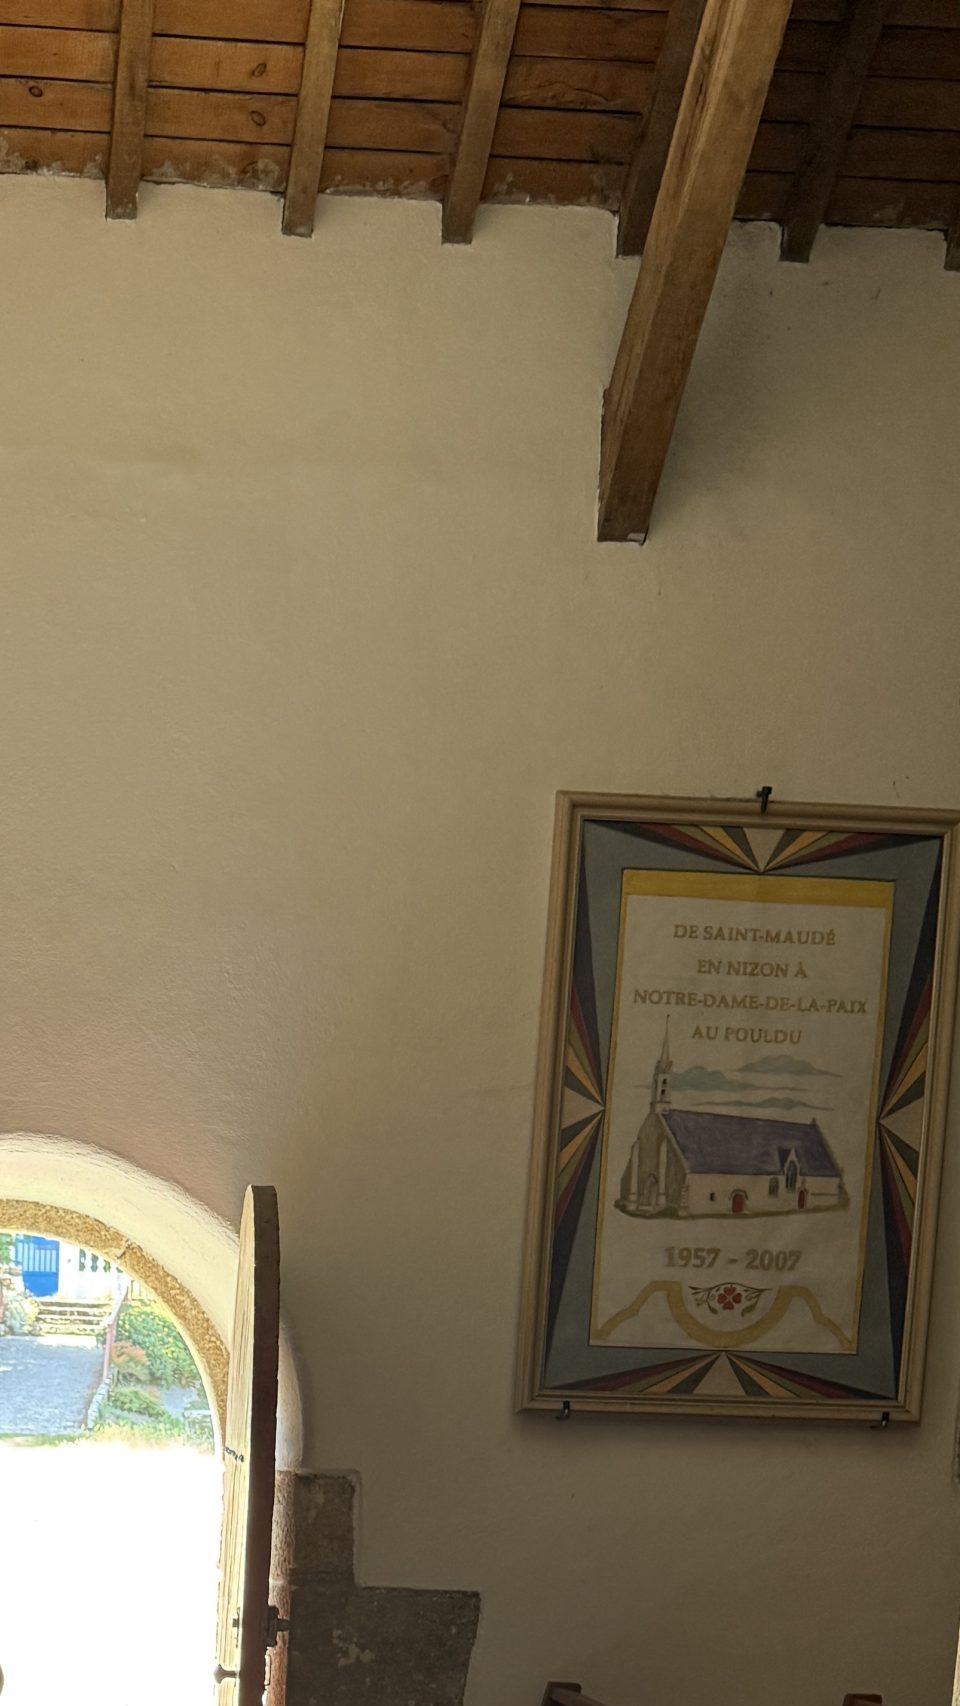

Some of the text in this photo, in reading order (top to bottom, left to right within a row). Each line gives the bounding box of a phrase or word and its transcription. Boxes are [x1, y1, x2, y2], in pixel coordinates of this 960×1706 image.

[673, 924, 836, 946] DE SAINT-MAUDÉ
[697, 959, 722, 975] EN
[727, 960, 790, 978] NIZON
[633, 989, 868, 1015] NOTRE-DAME-DE-LA-PAIX
[691, 1025, 803, 1045] AU POULDU
[664, 1246, 721, 1268] 1957
[745, 1248, 803, 1272] 2007
